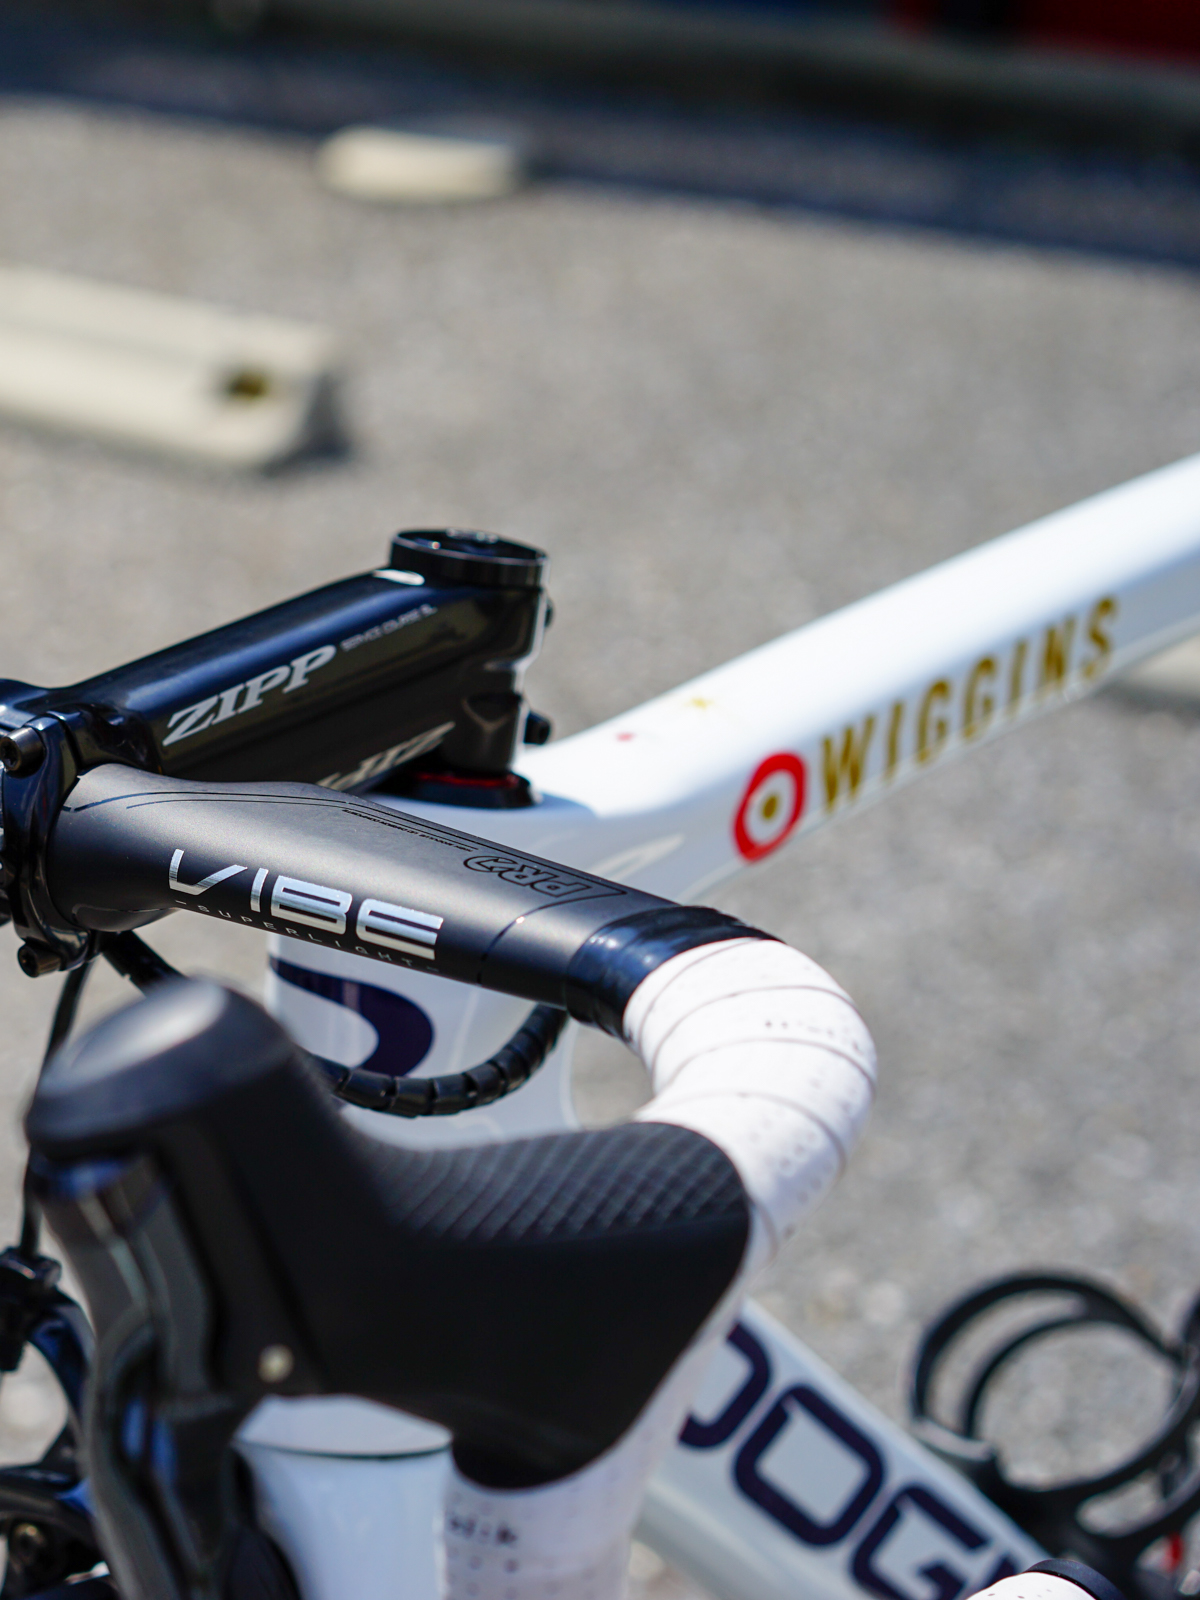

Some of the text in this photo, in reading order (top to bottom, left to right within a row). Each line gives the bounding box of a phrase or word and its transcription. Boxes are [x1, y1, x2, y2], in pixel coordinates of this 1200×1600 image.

[162, 644, 337, 747] ZIPP
[821, 596, 1118, 813] WIGGINS
[169, 849, 444, 960] VIBE
[463, 856, 593, 898] PRO
[196, 904, 413, 968] SUPERLIGHT
